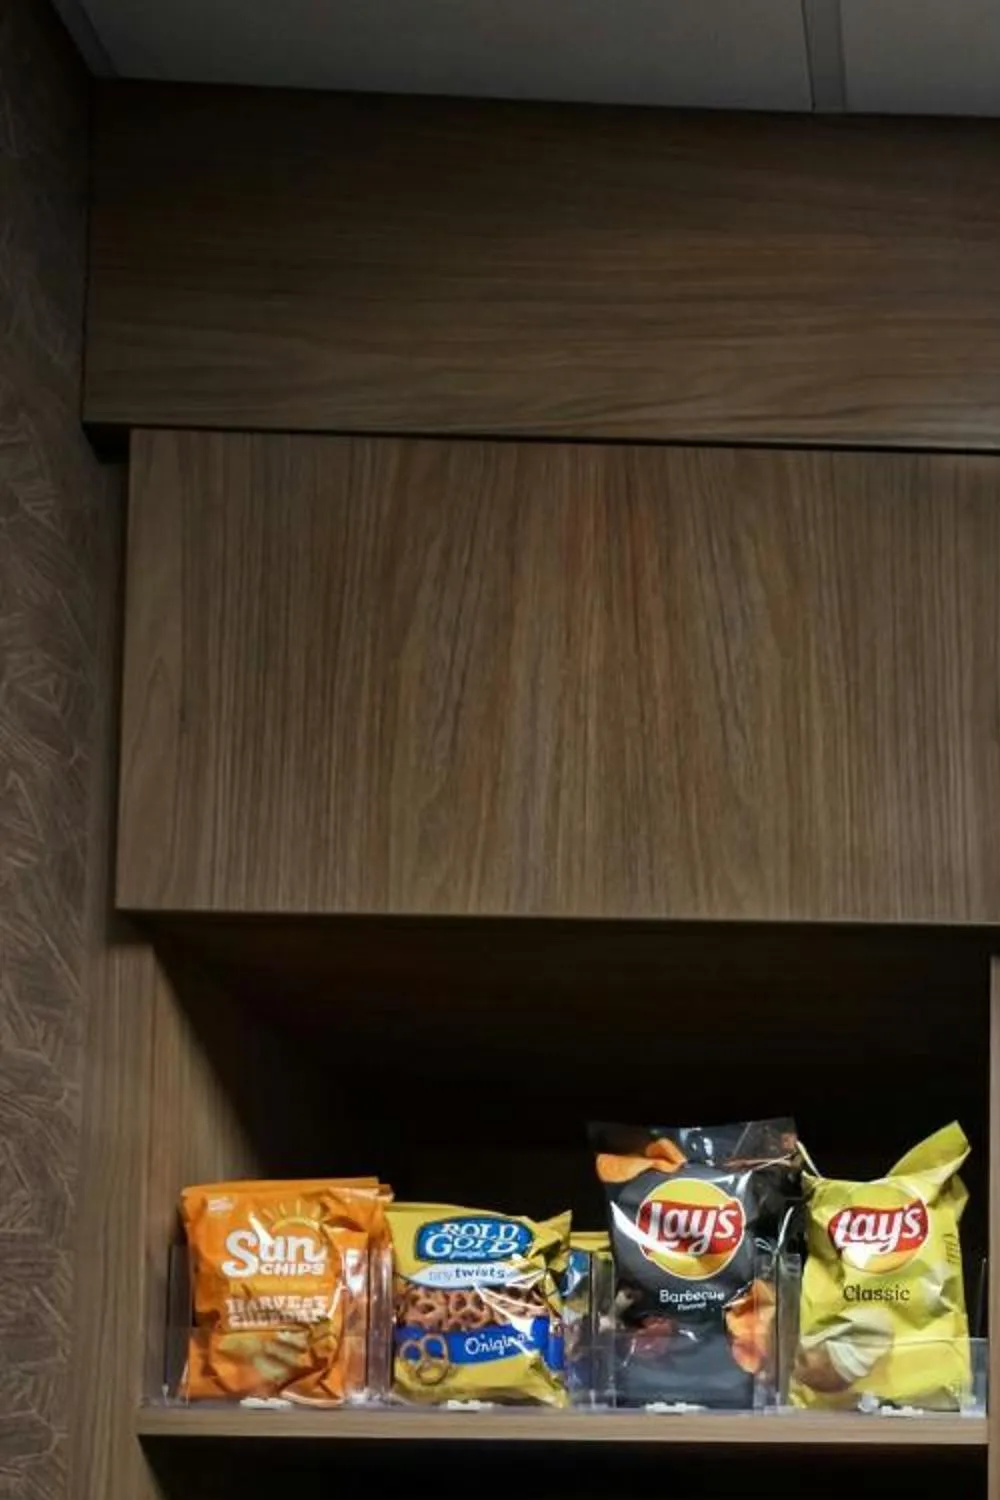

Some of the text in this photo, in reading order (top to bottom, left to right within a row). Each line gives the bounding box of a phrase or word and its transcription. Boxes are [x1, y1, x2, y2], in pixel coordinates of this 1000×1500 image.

[440, 1222, 519, 1240] ROLD
[647, 1201, 738, 1253] Lay's
[834, 1204, 923, 1254] Lay's
[221, 1230, 327, 1277] Sun
[425, 1233, 519, 1258] GOLD
[260, 1263, 325, 1276] CHIPS
[659, 1289, 725, 1303] Barbecue
[842, 1284, 912, 1302] Classic
